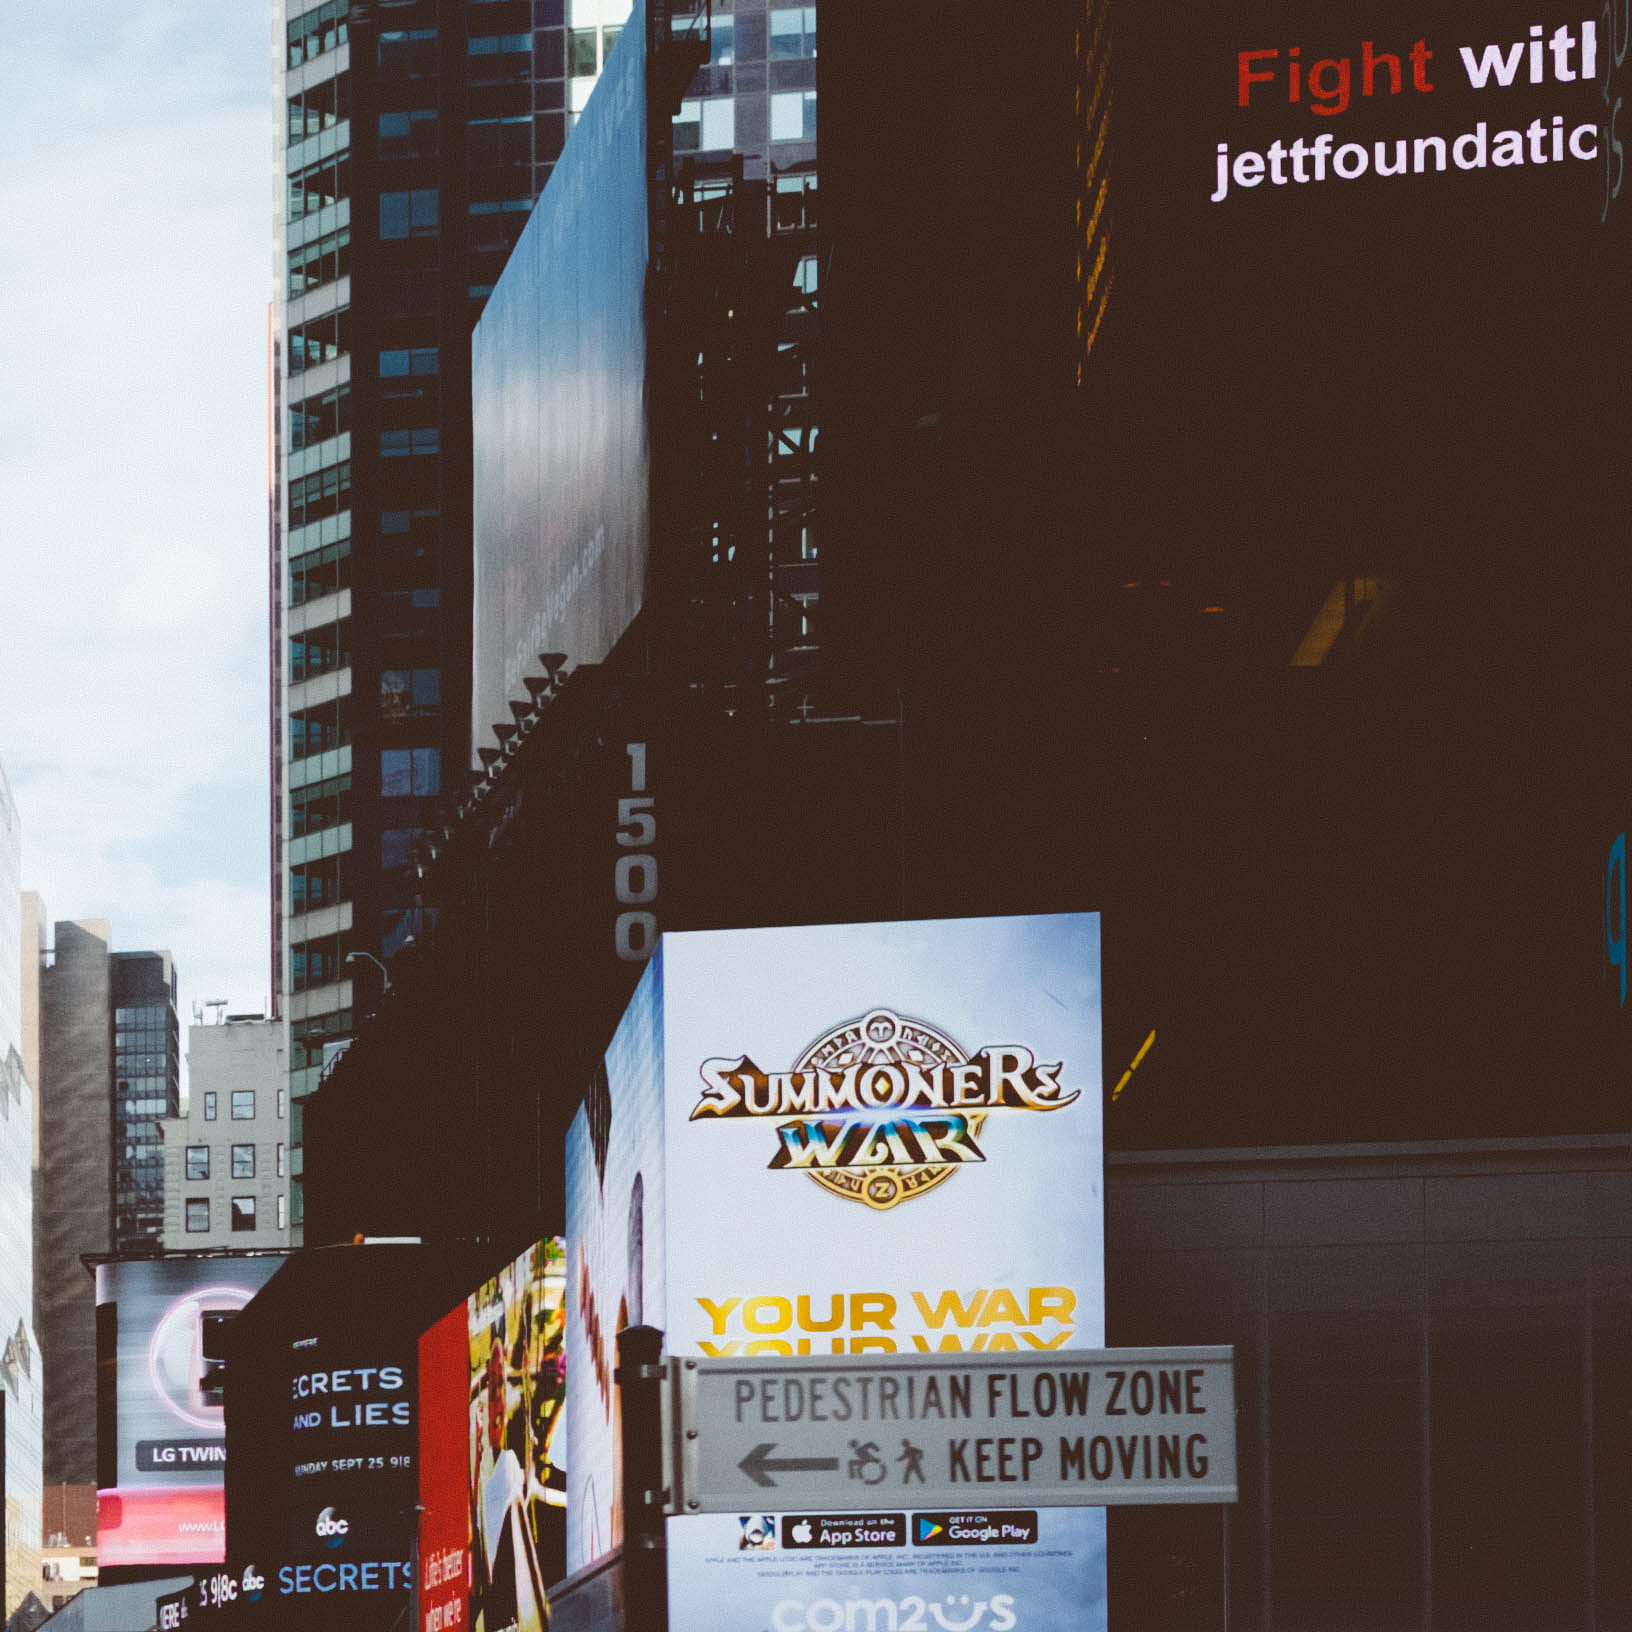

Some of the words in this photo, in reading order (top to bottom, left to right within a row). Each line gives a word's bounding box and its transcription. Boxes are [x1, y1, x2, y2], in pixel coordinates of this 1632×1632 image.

[1236, 36, 1436, 117] Fight
[614, 742, 659, 961] 1500
[778, 1113, 976, 1168] WAR
[696, 1293, 898, 1336] YOUR
[911, 1287, 1079, 1329] WAR
[735, 1375, 973, 1425] PEDESTRIAN
[986, 1370, 1093, 1420] FLOW
[1105, 1368, 1206, 1415] ZONE
[292, 1412, 322, 1430] AND
[331, 1402, 410, 1428] LIES
[153, 1448, 175, 1463] LG
[331, 1457, 364, 1471] SEPT
[367, 1457, 385, 1469] 25
[949, 1437, 1044, 1484] KEEP
[1059, 1433, 1209, 1482] MOVING
[315, 1519, 349, 1536] abc
[948, 1525, 1000, 1542] Google
[1001, 1524, 1030, 1541] Play
[949, 1516, 965, 1525] GET
[819, 1529, 852, 1546] App
[854, 1528, 897, 1543] Store
[442, 1547, 464, 1582] better
[242, 1573, 265, 1592] abc
